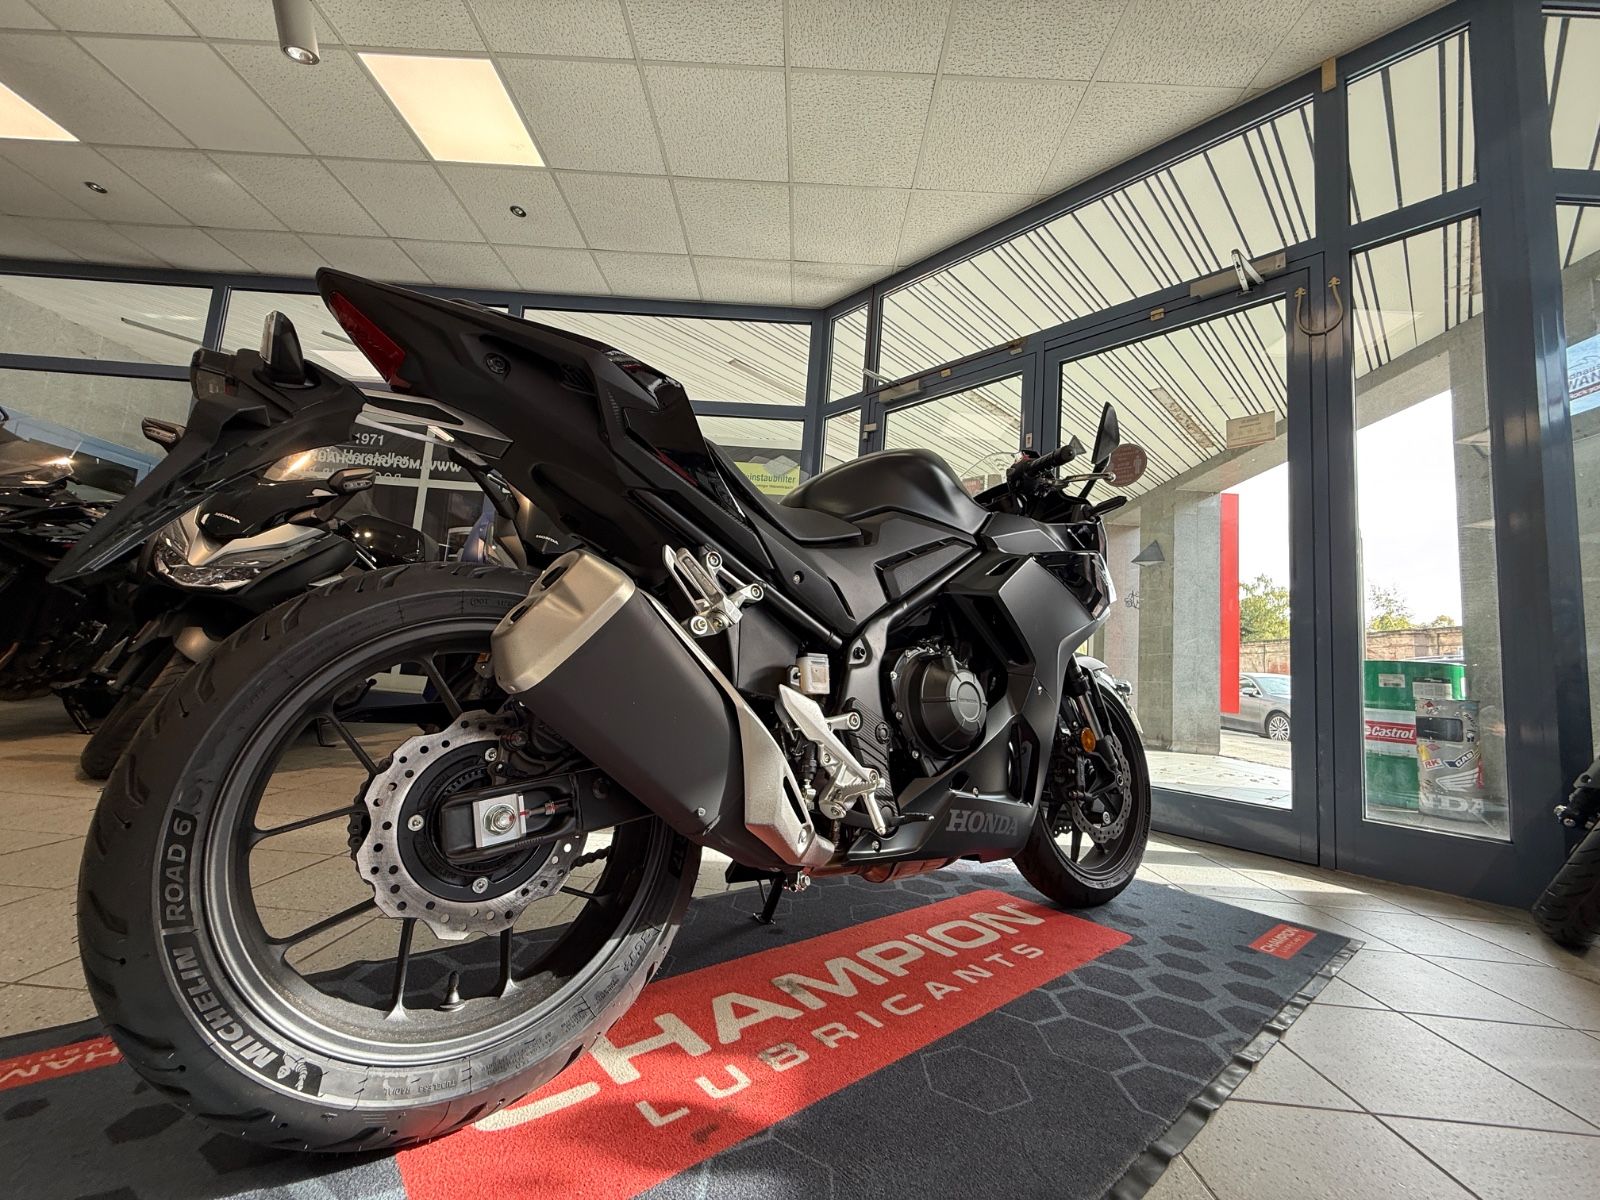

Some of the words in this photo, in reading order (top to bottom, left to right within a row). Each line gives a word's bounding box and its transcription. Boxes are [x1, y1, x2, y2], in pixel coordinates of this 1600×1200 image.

[214, 512, 240, 524] HONDA
[1372, 726, 1414, 739] Castrol
[173, 817, 192, 836] 6
[946, 809, 1019, 836] HONDA
[164, 846, 187, 921] ROAD
[172, 947, 279, 1069] MICHELIN
[635, 943, 1045, 1128] LUBRICANTS
